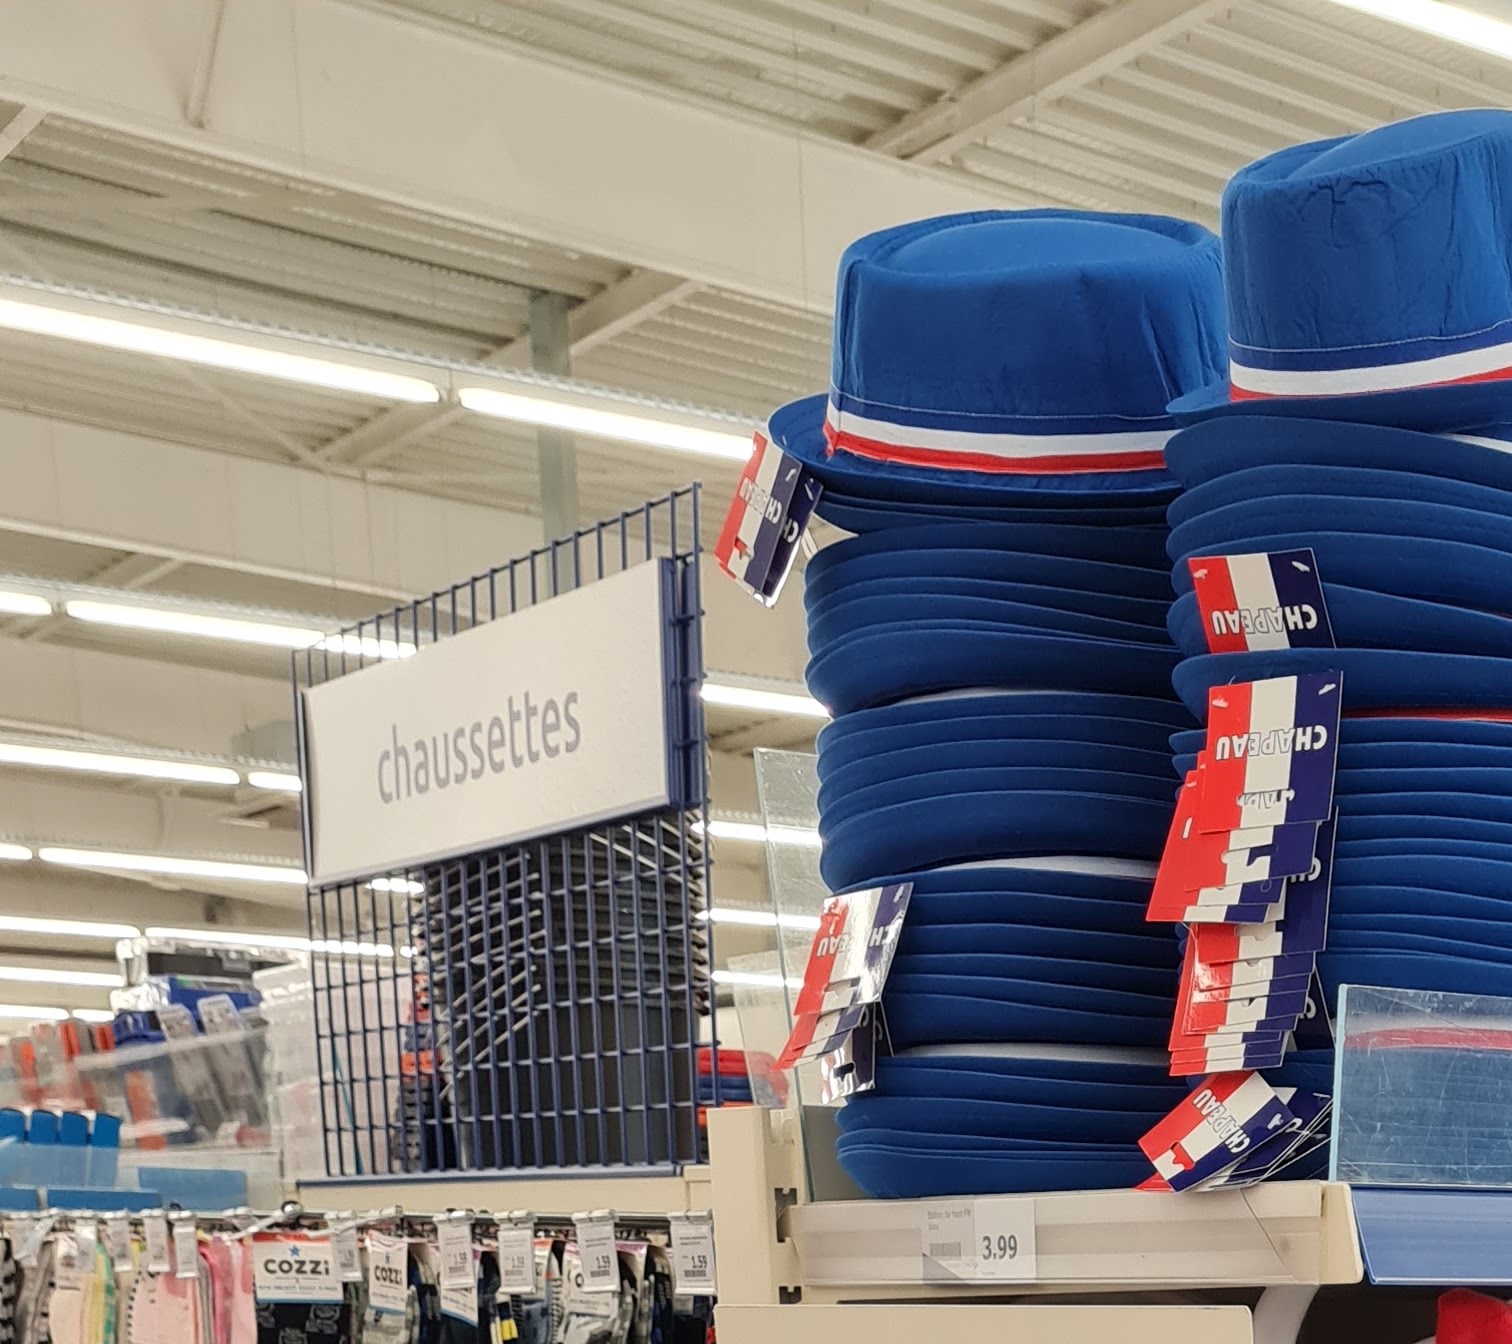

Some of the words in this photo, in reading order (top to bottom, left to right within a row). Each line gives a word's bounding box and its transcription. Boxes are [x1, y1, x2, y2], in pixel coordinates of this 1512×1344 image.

[1211, 604, 1318, 636] CHAPEAU
[378, 690, 581, 804] chaussettes
[1215, 724, 1328, 761] CHAPEAU
[1192, 1089, 1250, 1153] CHAPEAU
[982, 1234, 1018, 1260] 3.99
